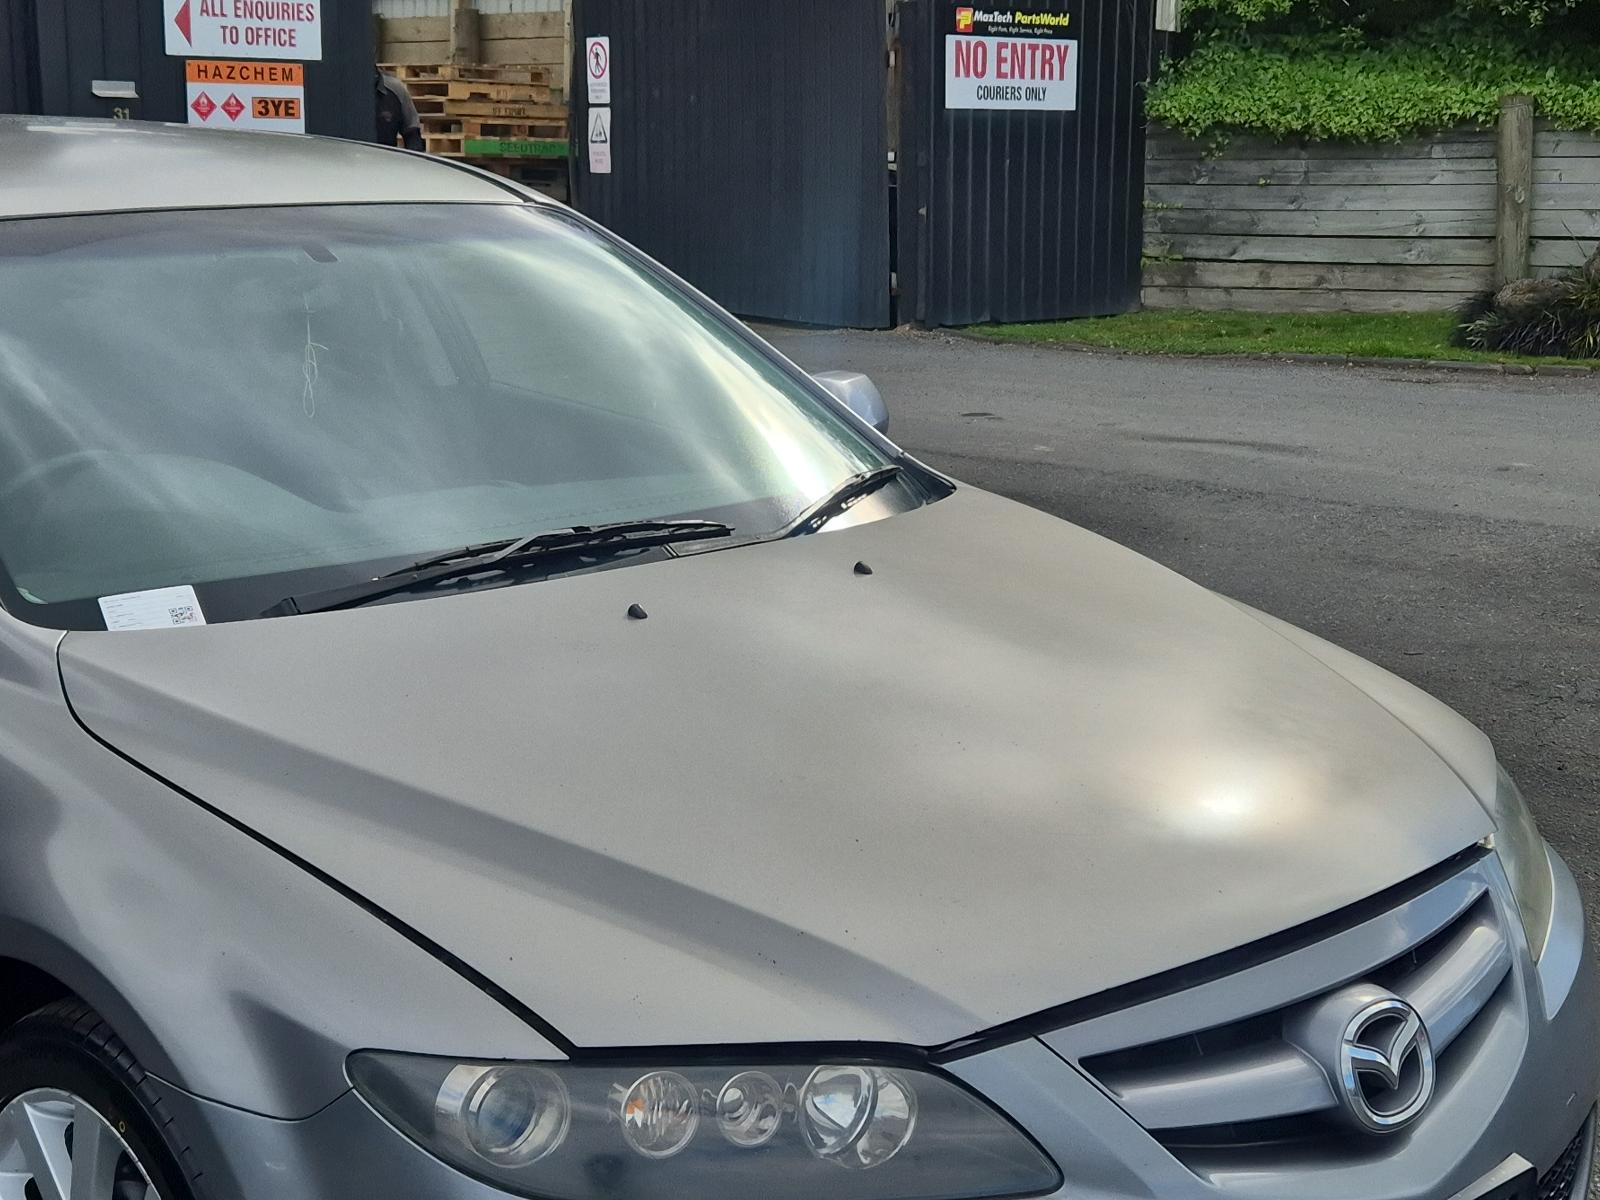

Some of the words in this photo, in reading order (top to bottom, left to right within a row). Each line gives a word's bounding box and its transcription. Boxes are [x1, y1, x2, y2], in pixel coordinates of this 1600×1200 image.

[200, 0, 227, 17] ALL
[234, 0, 315, 22] ENQUIRIES
[973, 10, 1013, 23] MaxTech
[1015, 11, 1070, 26] PartsWorld
[220, 25, 239, 45] TO
[245, 27, 297, 47] OFFICE
[954, 39, 987, 78] NO
[996, 41, 1069, 81] ENTRY
[197, 65, 294, 82] HAZCHEM
[976, 85, 1022, 101] COURIERS
[1025, 87, 1047, 102] ONLY
[113, 107, 130, 120] 31
[258, 99, 296, 117] 3YE
